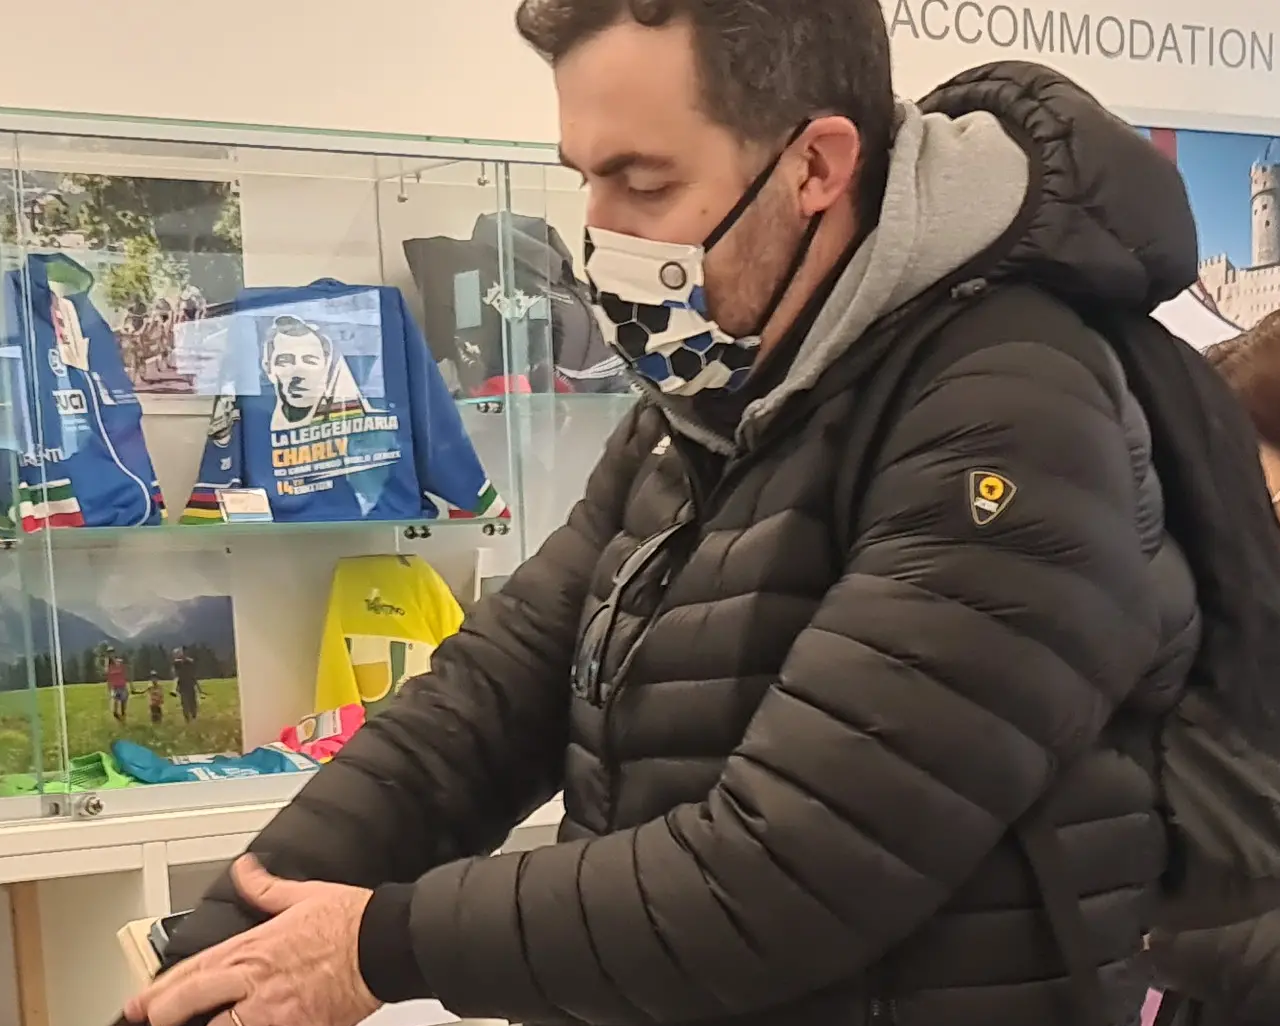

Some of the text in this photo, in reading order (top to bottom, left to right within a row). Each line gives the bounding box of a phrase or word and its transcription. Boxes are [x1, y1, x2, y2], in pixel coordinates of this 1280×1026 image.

[889, 0, 1274, 72] ACCOMMODATION
[290, 415, 399, 445] LEGGENDARIA
[272, 435, 348, 468] CHARLY
